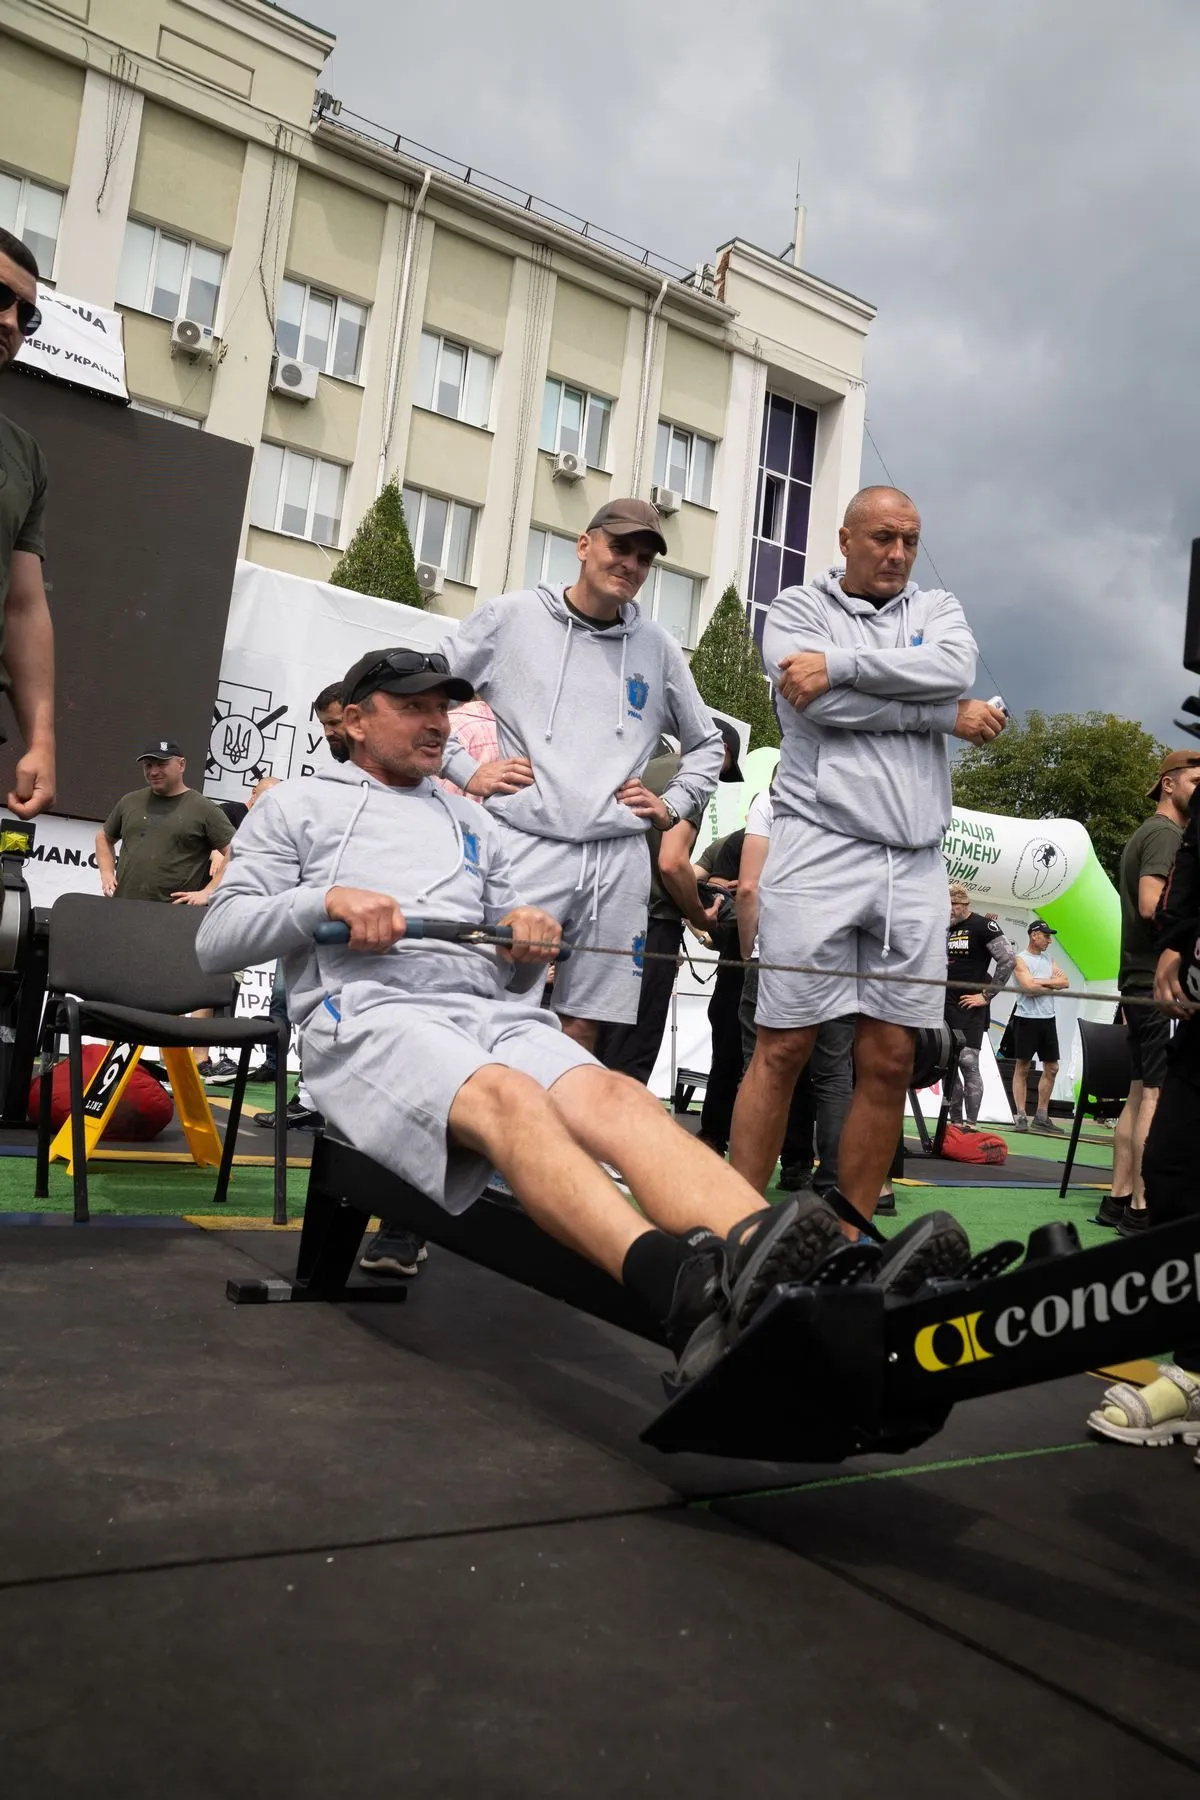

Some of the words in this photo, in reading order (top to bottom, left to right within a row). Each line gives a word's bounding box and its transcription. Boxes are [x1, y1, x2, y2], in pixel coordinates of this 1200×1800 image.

[64, 350, 120, 383] УКРАЇНИ
[947, 818, 995, 842] РАЦІЯ
[85, 1099, 104, 1112] LINE
[994, 1252, 1200, 1347] conce
